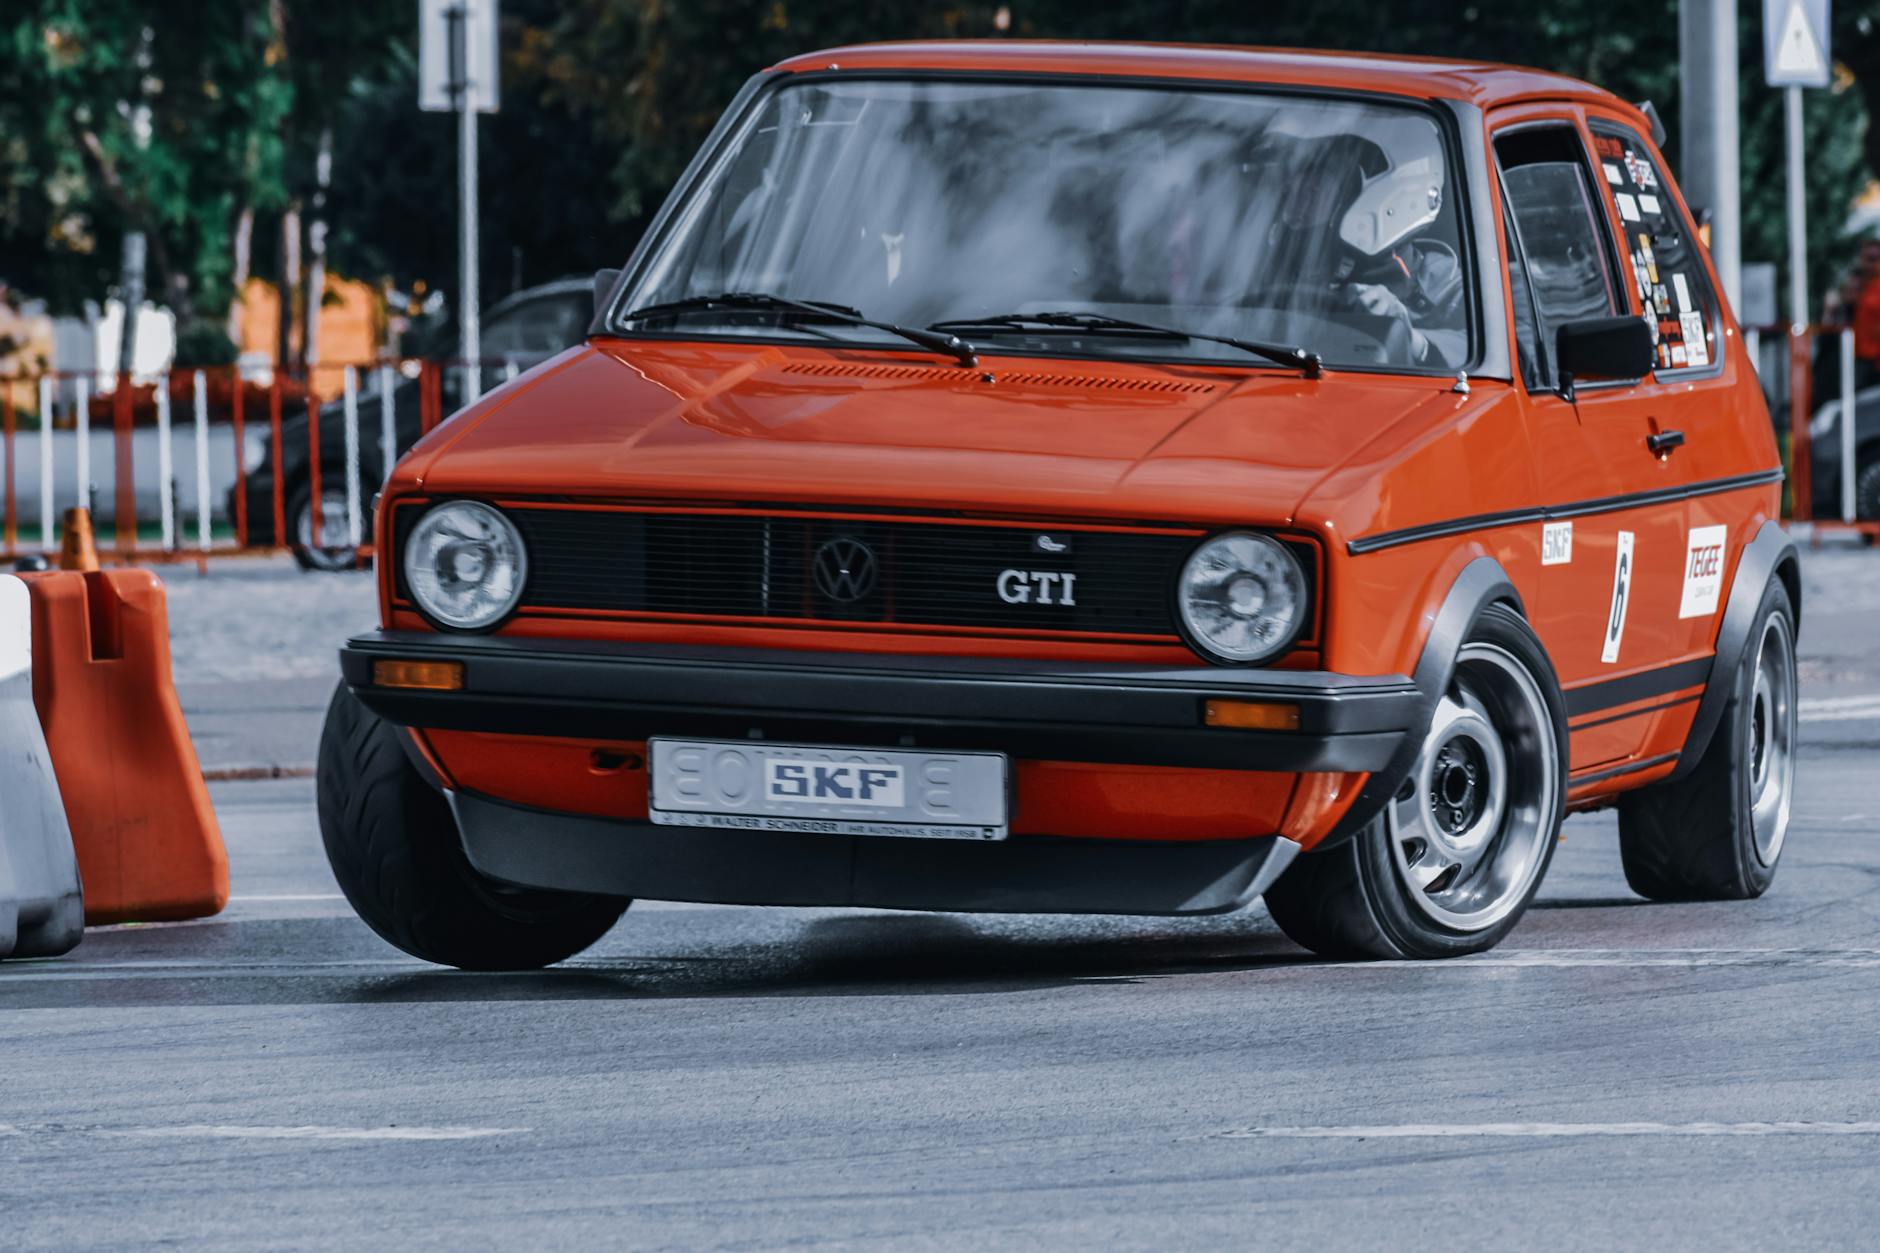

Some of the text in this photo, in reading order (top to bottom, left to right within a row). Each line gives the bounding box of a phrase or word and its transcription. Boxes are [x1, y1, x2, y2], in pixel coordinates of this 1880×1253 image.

[1544, 527, 1571, 560] SKF
[997, 569, 1077, 606] GTI
[1611, 553, 1627, 642] 6
[772, 764, 898, 799] SKF
[711, 816, 761, 829] WALTER
[767, 819, 838, 833] SCHNEIDER
